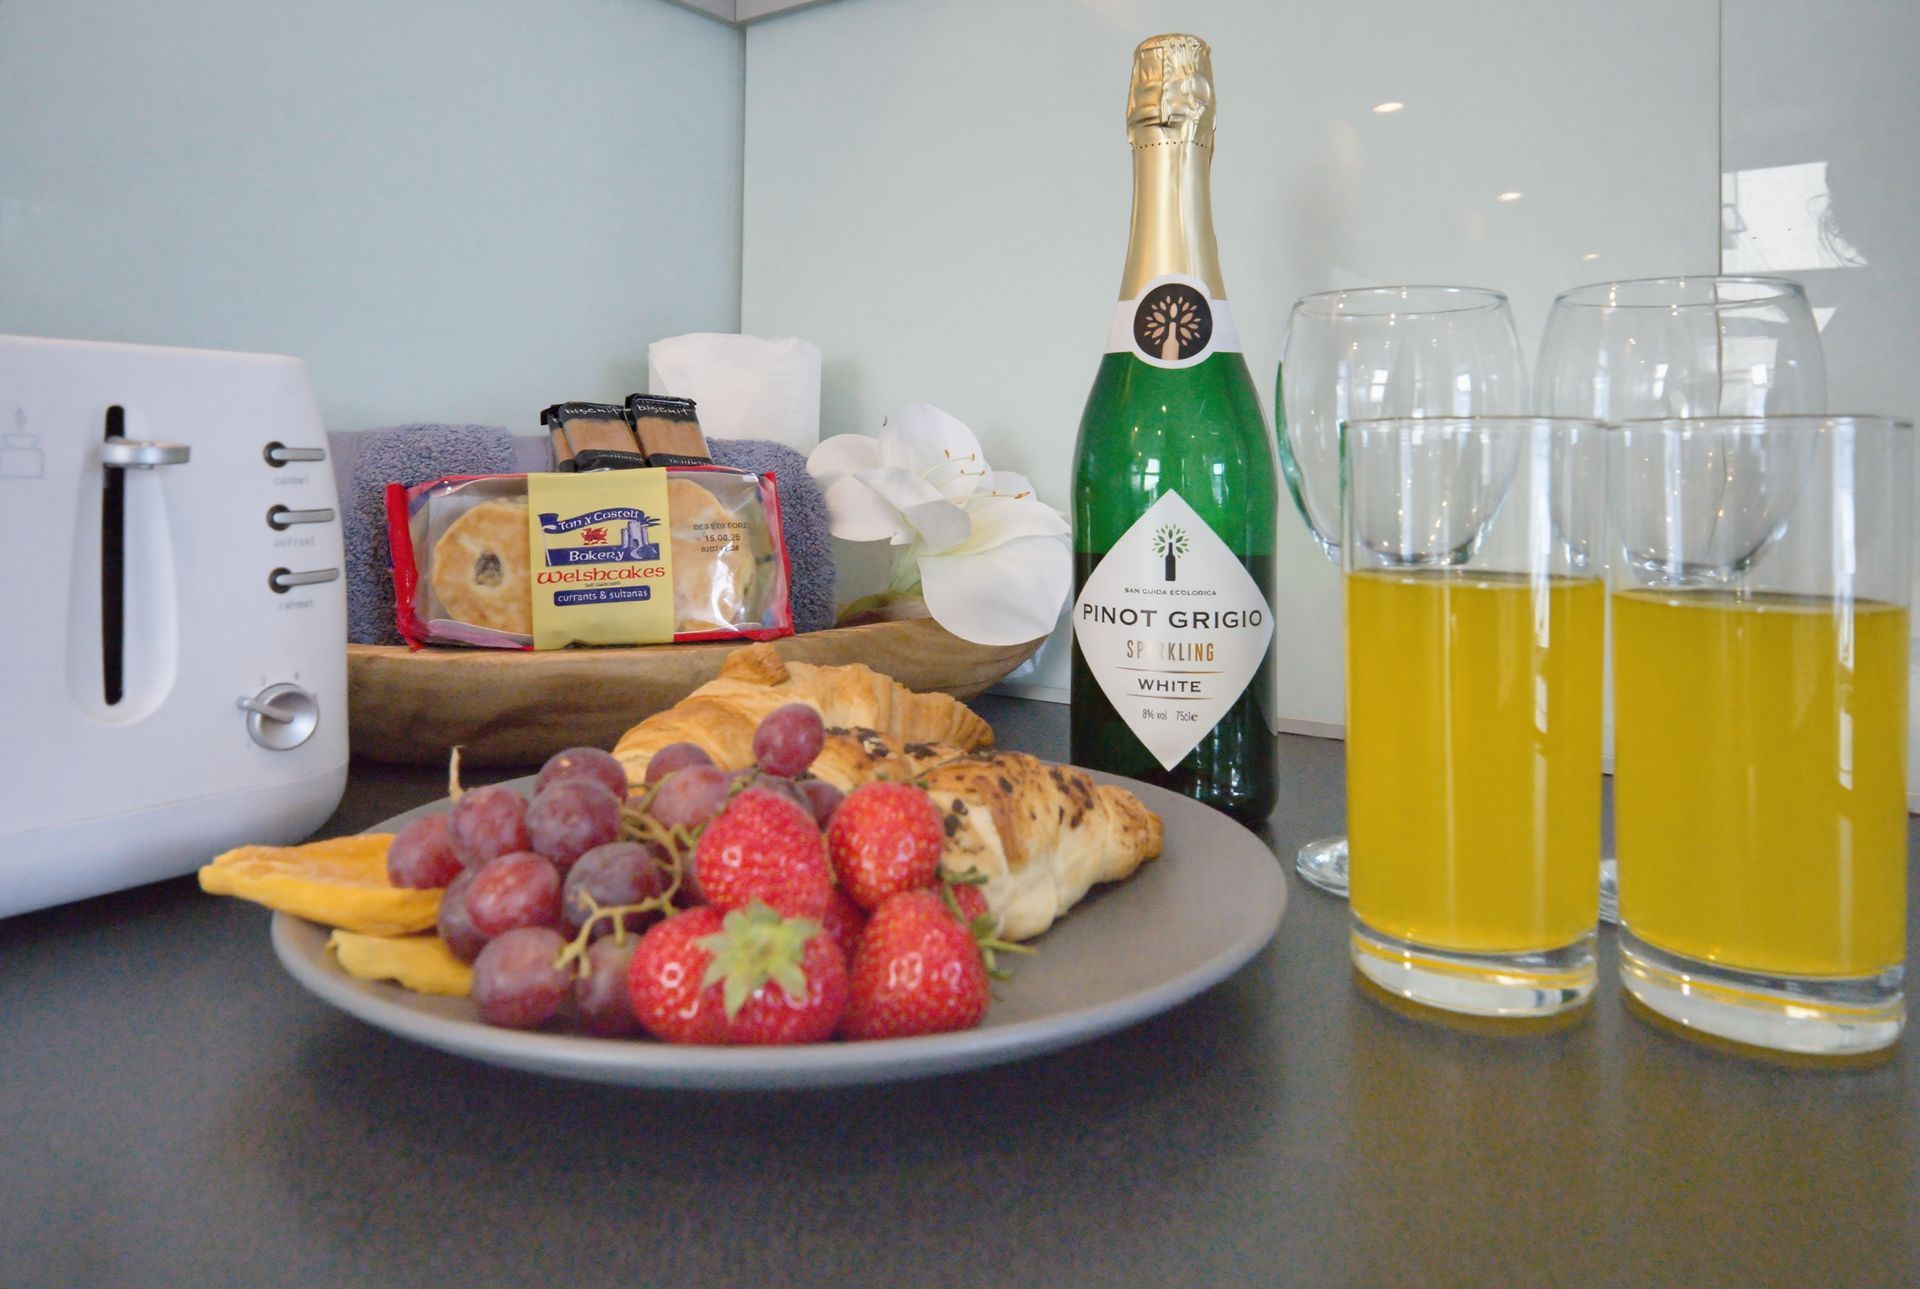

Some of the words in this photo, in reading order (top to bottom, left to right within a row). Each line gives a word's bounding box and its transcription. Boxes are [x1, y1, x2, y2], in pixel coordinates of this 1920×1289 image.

[558, 519, 582, 531] Tan
[569, 550, 625, 562] Bakery
[557, 591, 598, 602] currants
[599, 591, 607, 600] &
[609, 588, 648, 599] sultanas
[1083, 603, 1157, 628] PINOT
[1168, 609, 1263, 629] GRIGIO
[1126, 639, 1215, 662] SPRKLING
[1138, 678, 1201, 693] WHITE
